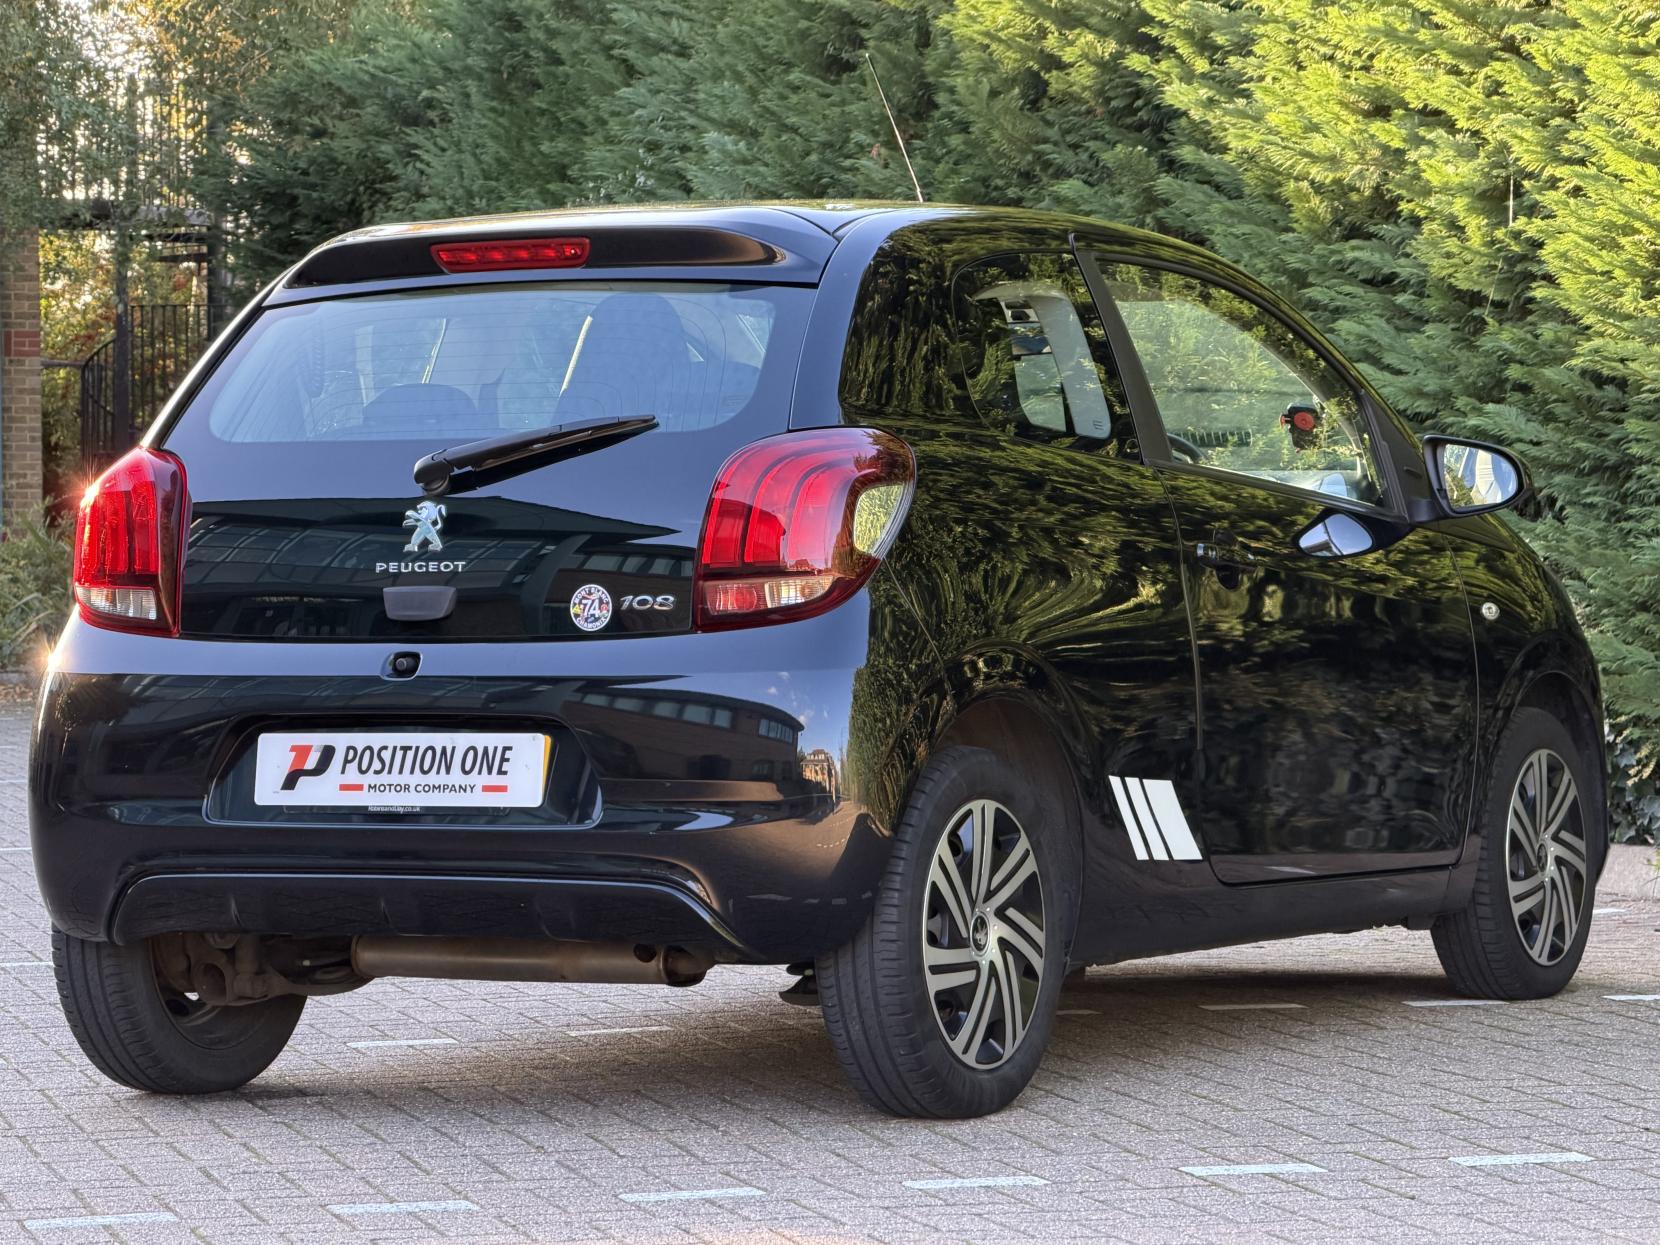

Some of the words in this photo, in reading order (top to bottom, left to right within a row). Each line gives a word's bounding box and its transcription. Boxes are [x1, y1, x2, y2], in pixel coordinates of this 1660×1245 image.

[375, 561, 466, 573] PEUGEOT
[574, 587, 589, 603] MONT
[590, 587, 609, 604] BLANC
[620, 595, 675, 611] 108
[582, 599, 601, 618] 74
[576, 617, 607, 629] CHAMONIX
[340, 745, 456, 775] POSITION
[460, 745, 513, 776] ONE
[368, 783, 411, 793] MOTOR
[414, 784, 476, 794] COMPANY
